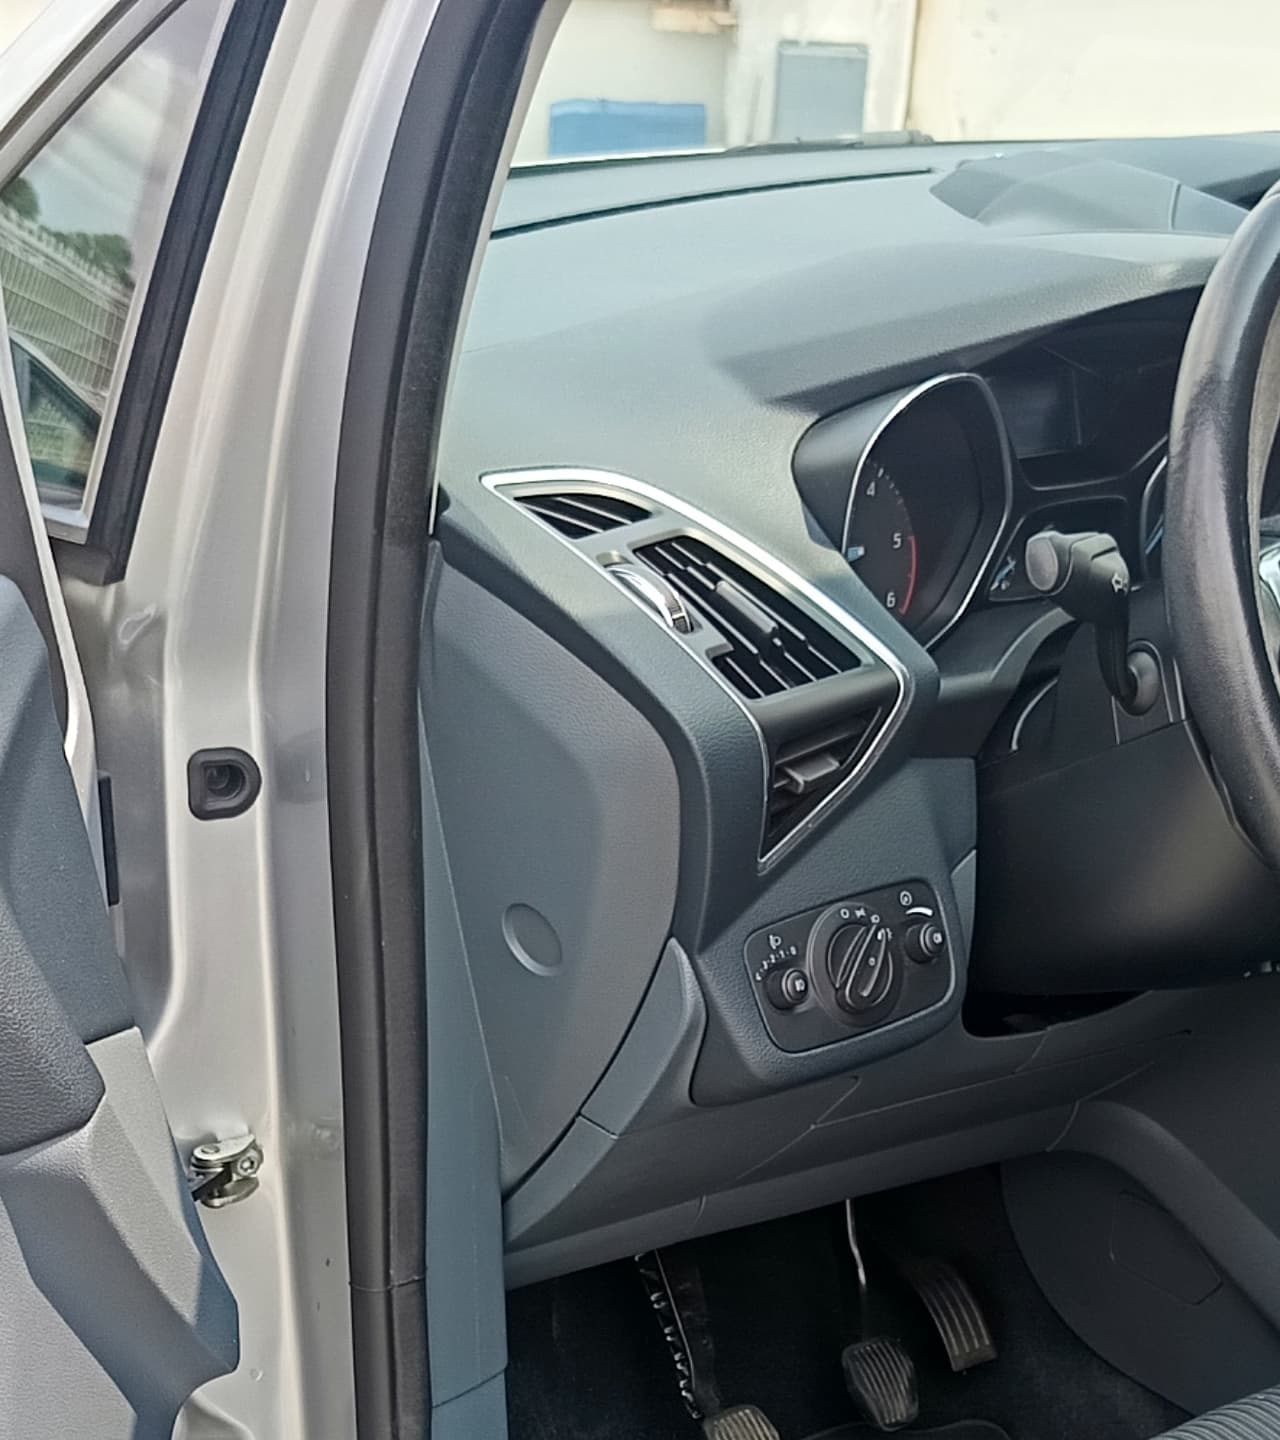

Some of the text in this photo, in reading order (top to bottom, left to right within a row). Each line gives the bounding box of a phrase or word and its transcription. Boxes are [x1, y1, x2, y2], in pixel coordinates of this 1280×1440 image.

[866, 481, 876, 497] 4
[892, 532, 902, 549] 5
[886, 591, 896, 608] 6
